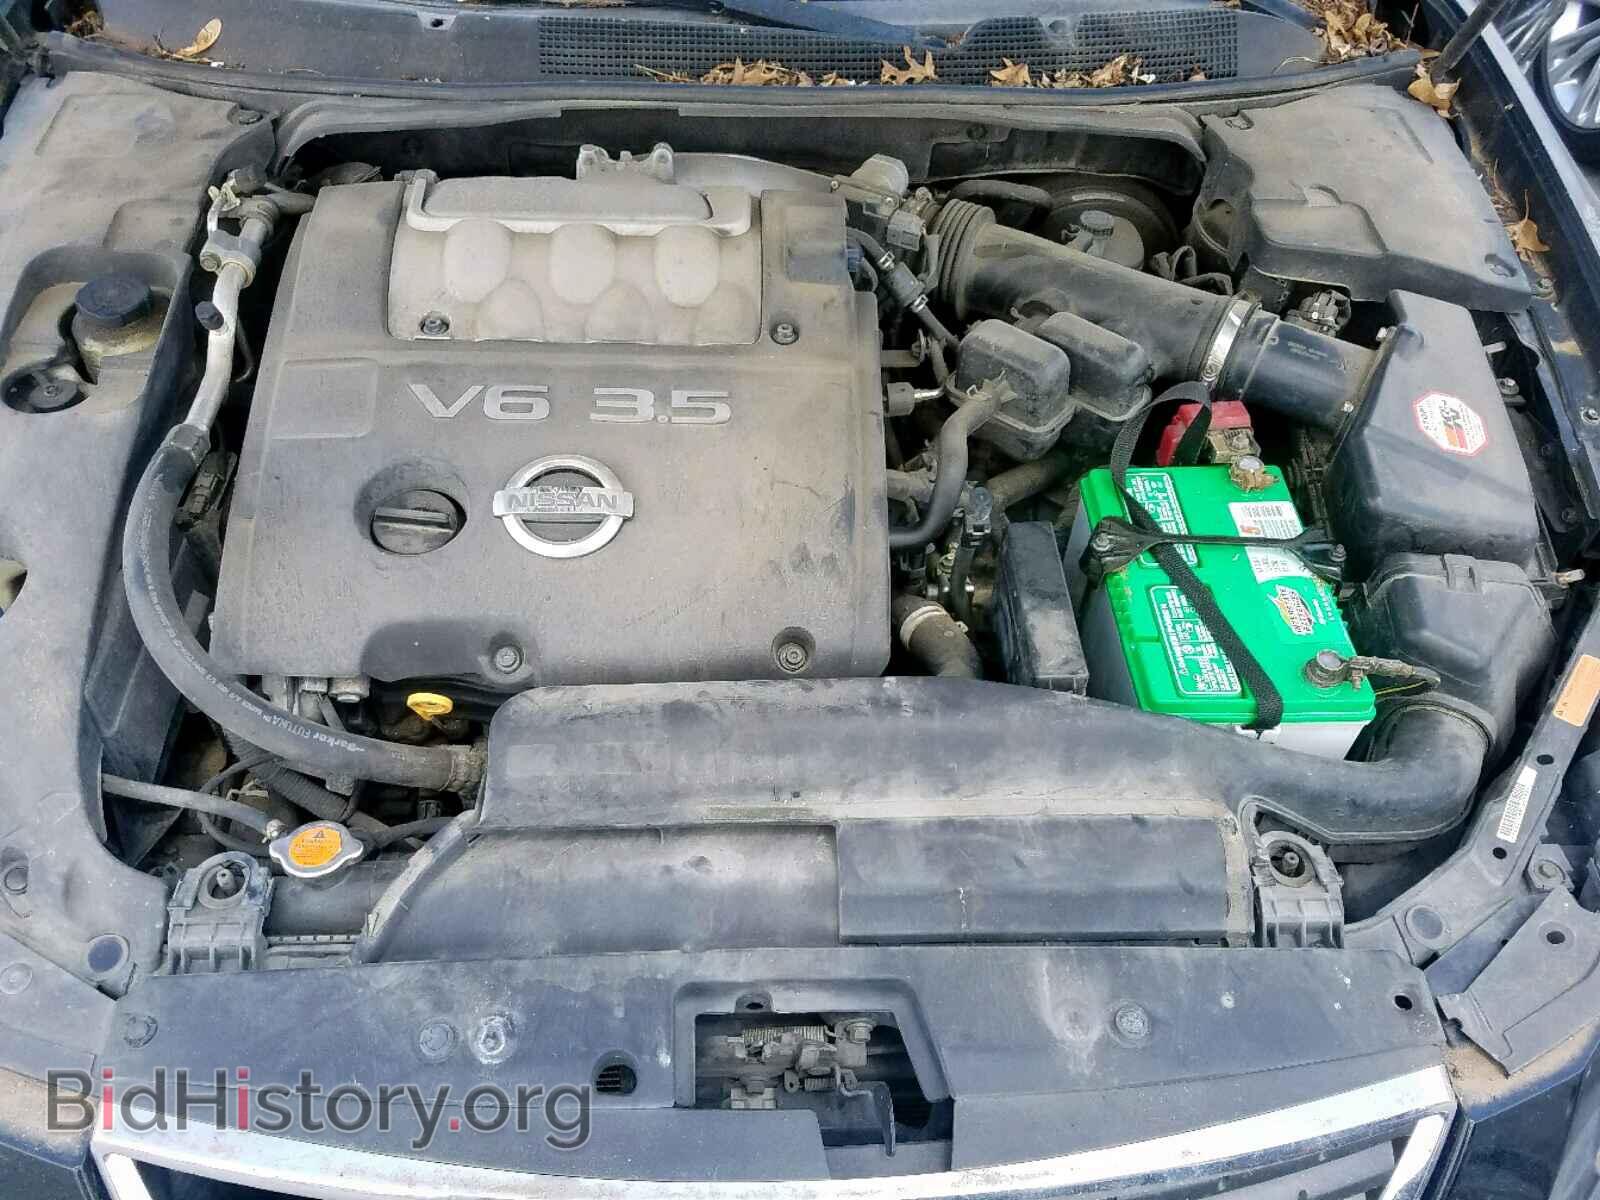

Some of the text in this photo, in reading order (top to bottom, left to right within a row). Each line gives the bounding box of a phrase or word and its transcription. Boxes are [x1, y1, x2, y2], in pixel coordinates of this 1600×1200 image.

[408, 383, 733, 424] V6 3.5
[506, 491, 619, 511] NISSAN
